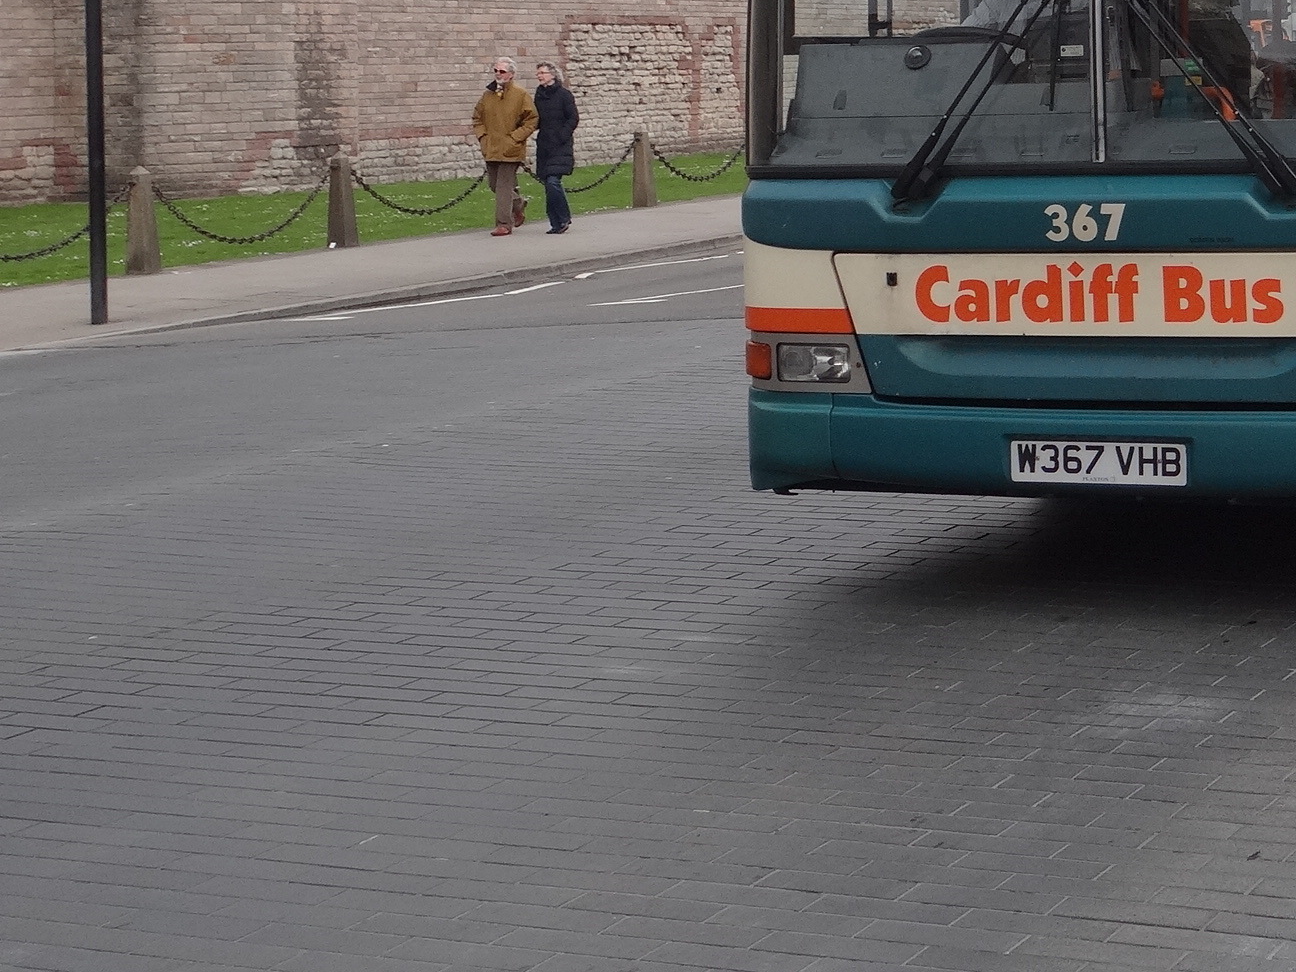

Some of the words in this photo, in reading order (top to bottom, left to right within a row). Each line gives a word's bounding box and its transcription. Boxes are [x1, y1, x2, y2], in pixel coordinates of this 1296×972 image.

[1044, 203, 1127, 243] 367
[915, 263, 1139, 323] Cardiff
[1162, 265, 1285, 325] Bus
[1017, 442, 1107, 475] W367
[1114, 444, 1183, 477] VHB
